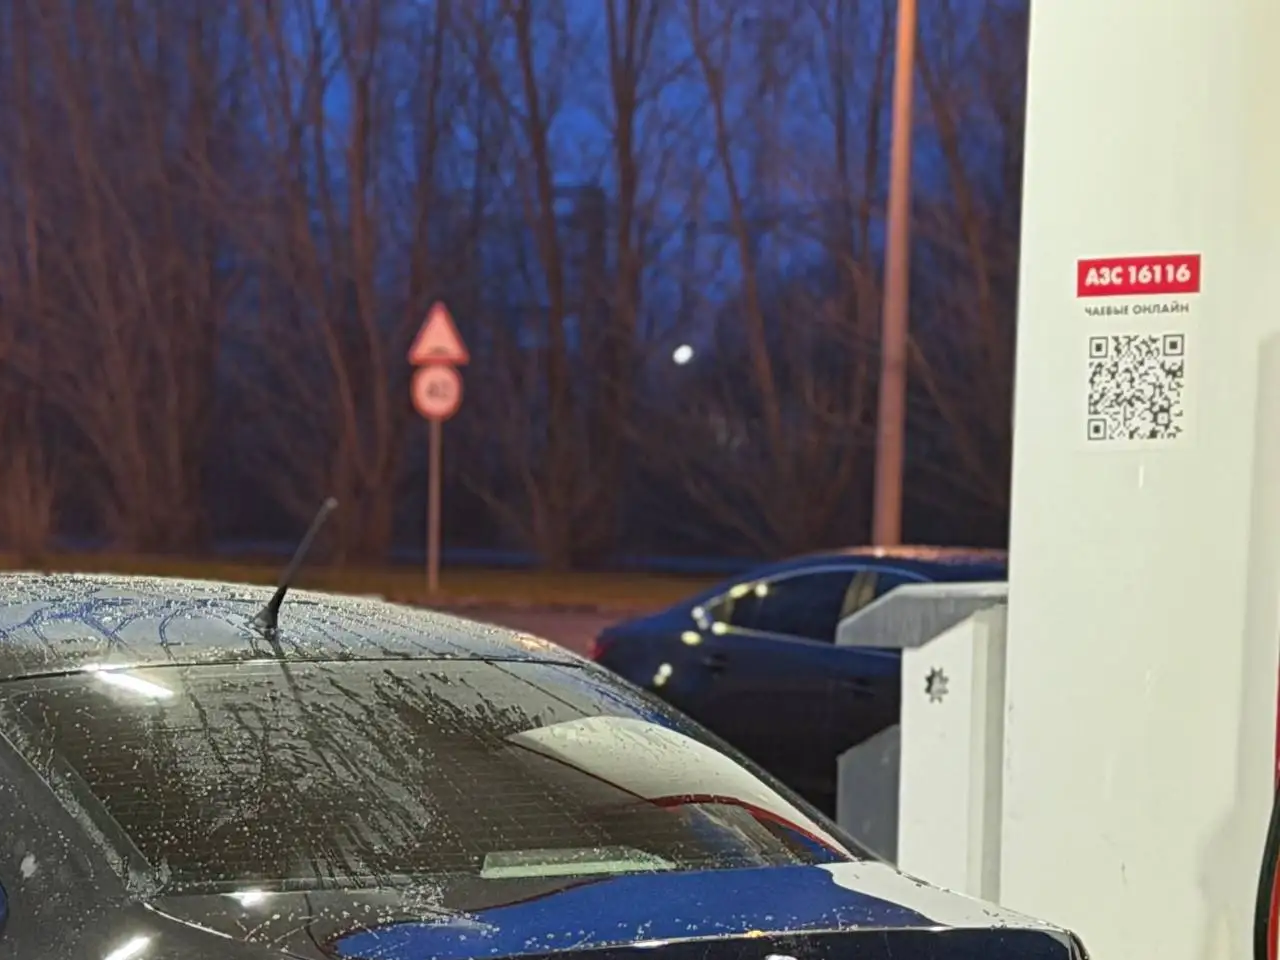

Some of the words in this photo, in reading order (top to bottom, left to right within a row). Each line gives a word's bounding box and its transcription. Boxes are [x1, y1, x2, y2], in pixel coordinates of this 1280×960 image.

[1085, 266, 1123, 286] АЗС
[1128, 264, 1191, 284] 16116
[1084, 305, 1129, 316] ЧАЕВЫЕ
[1132, 301, 1189, 315] ОНЛАЙН
